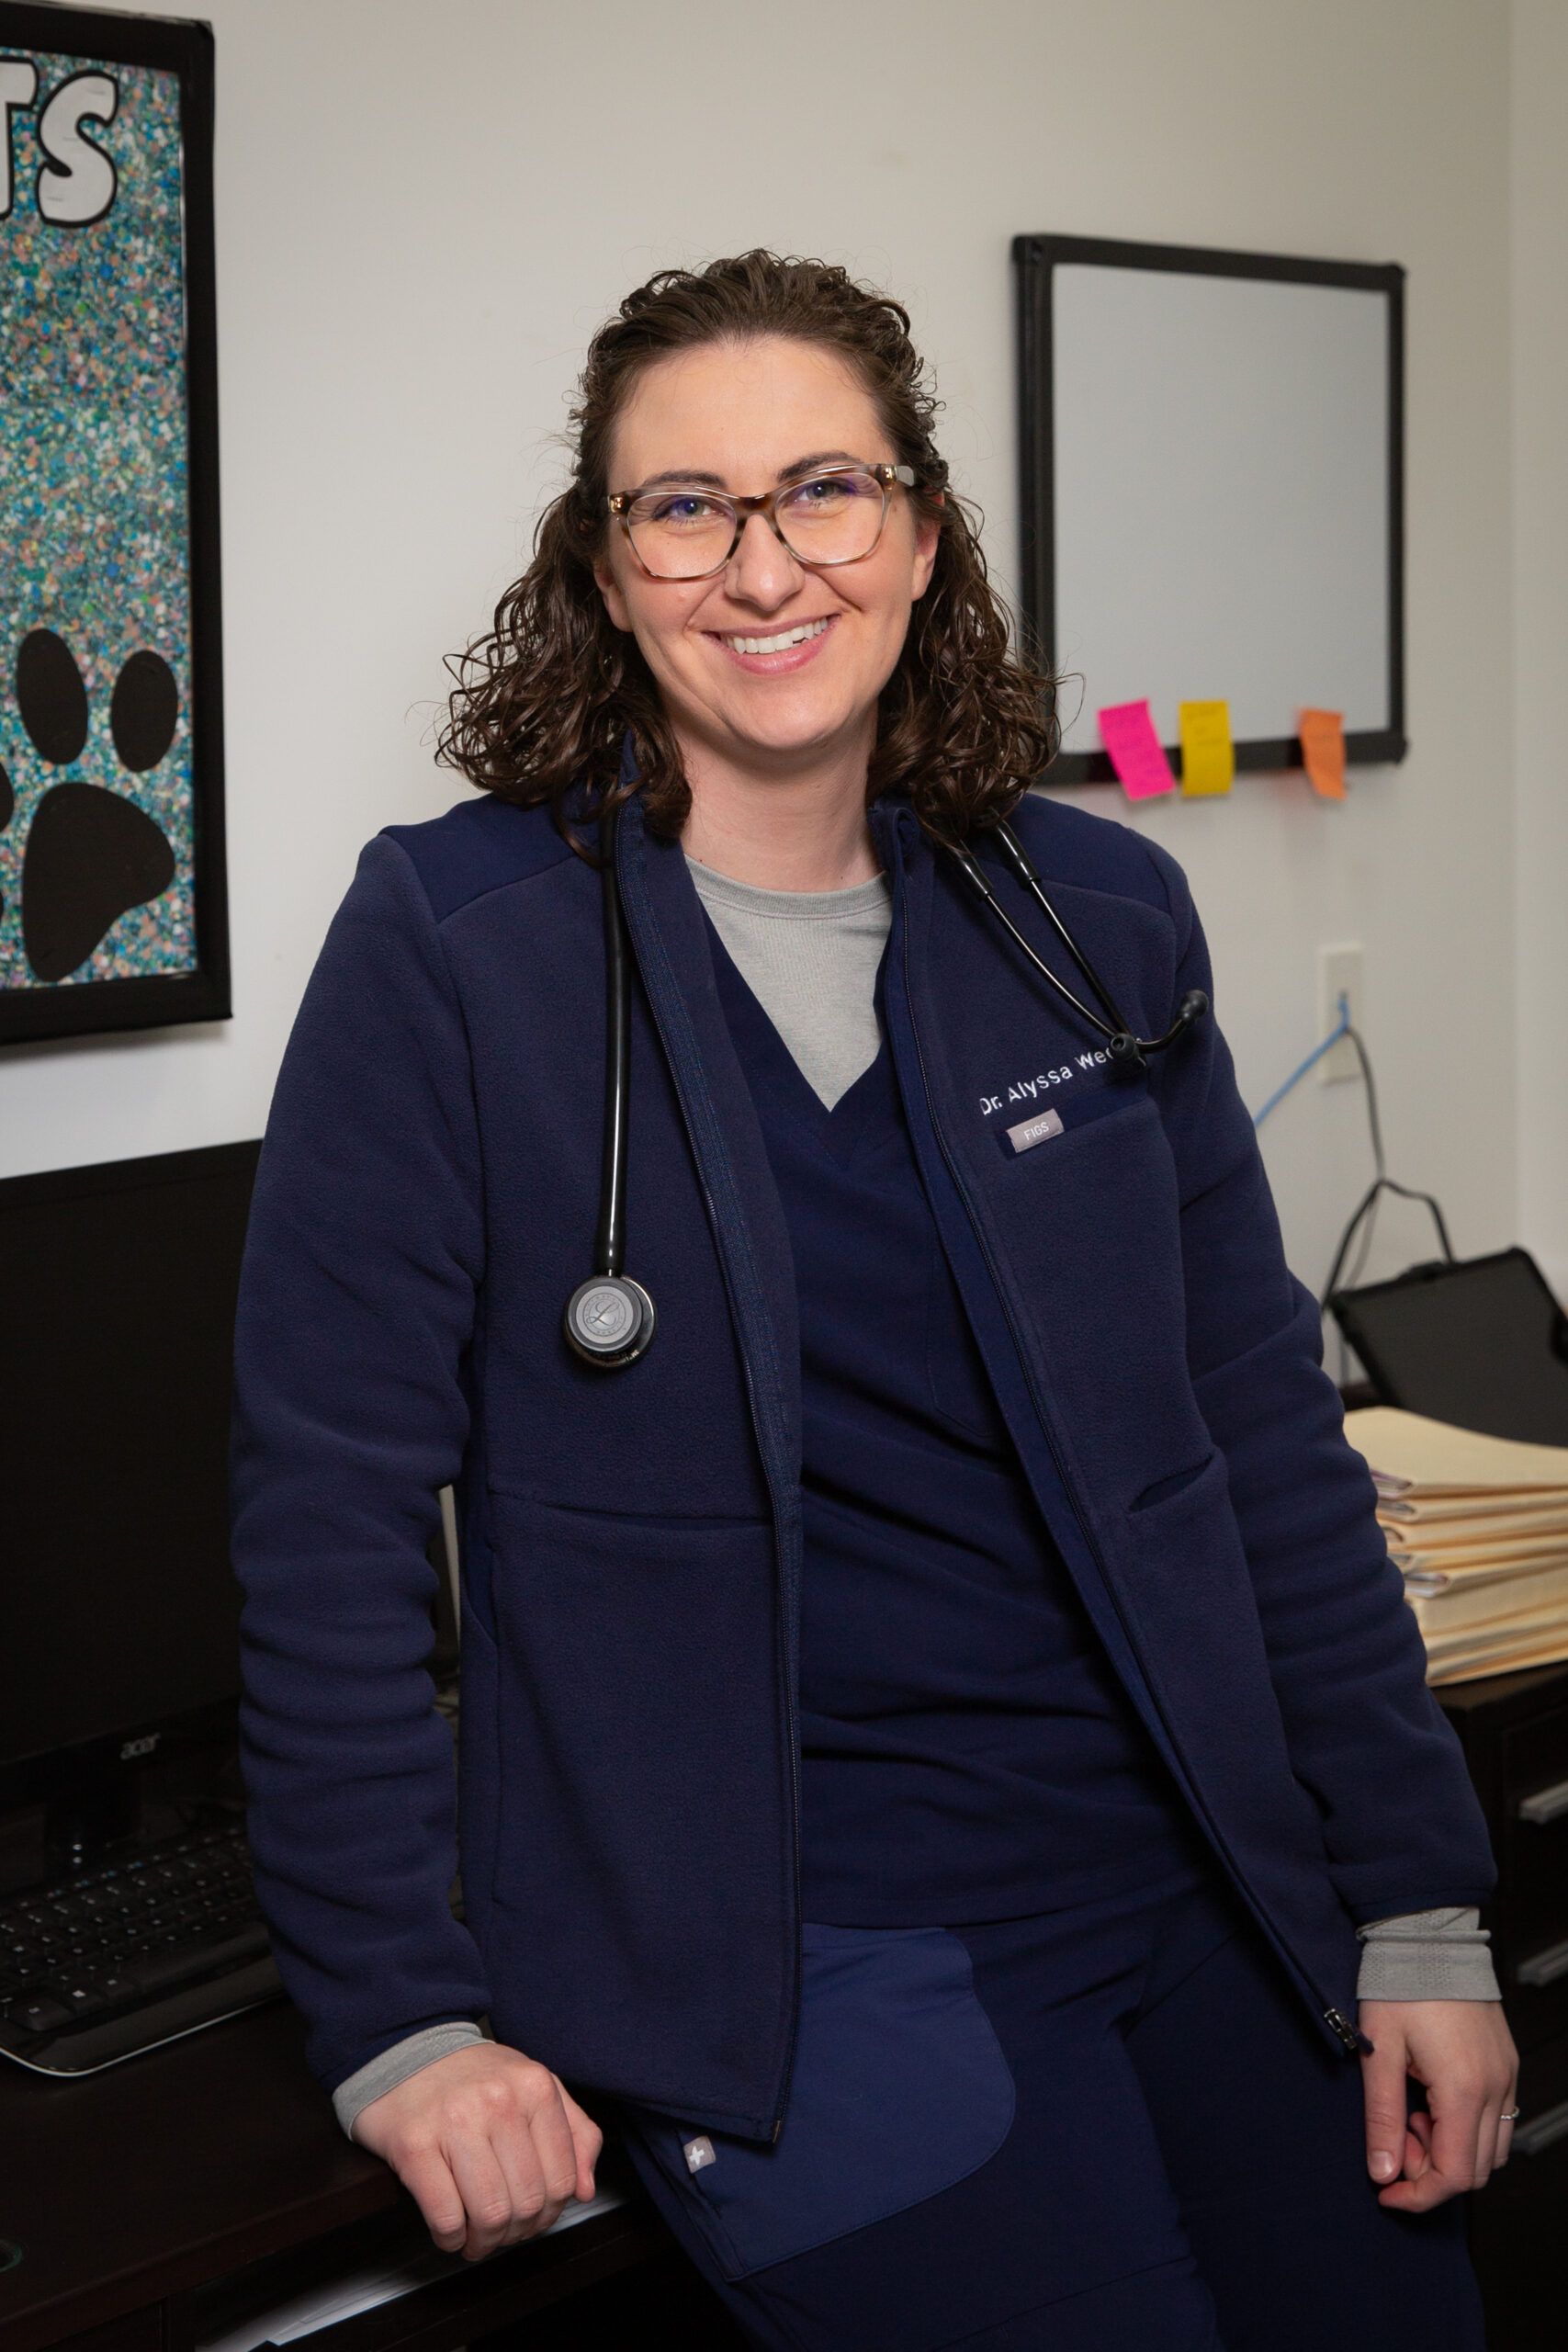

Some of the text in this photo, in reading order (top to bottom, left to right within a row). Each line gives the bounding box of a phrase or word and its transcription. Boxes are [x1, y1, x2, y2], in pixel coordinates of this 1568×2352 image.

[979, 1096, 1002, 1115] Dr.
[1008, 1066, 1073, 1102] Alyssa
[1023, 1122, 1050, 1141] FIGS
